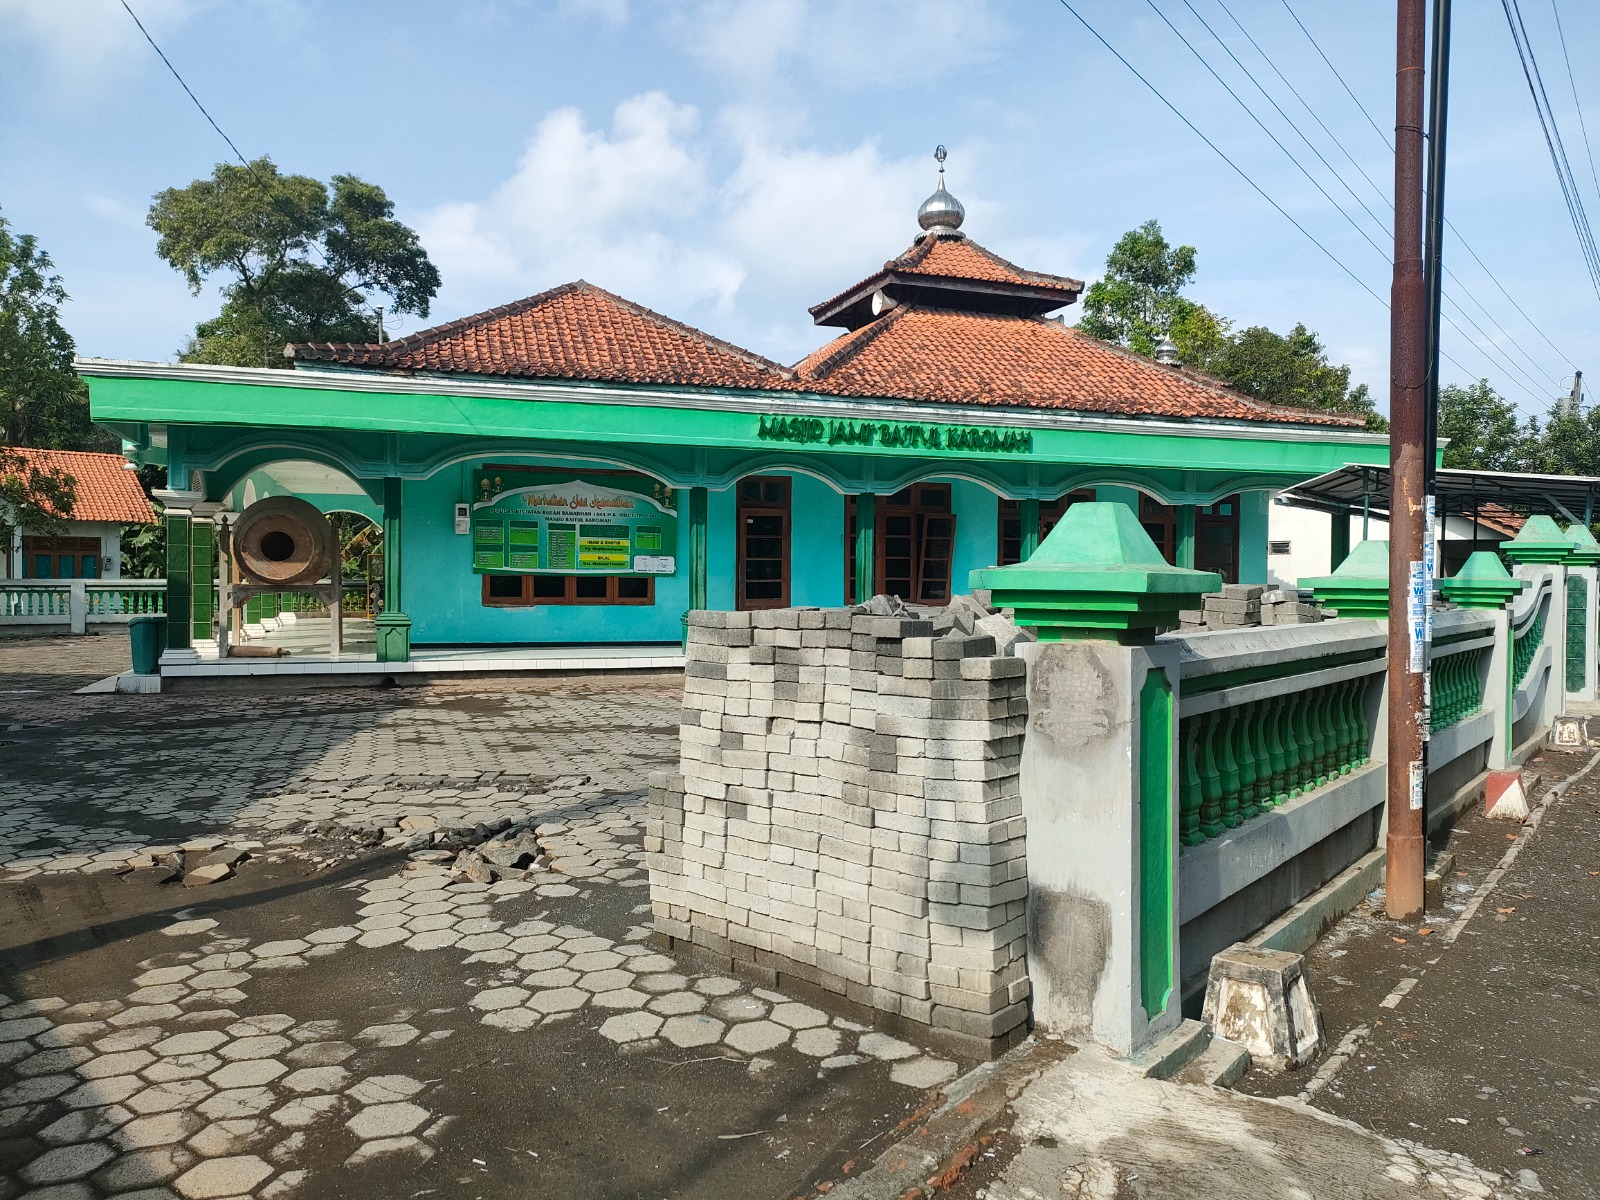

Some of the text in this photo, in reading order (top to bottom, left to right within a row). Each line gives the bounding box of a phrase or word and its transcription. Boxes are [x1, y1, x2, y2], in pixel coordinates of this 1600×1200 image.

[758, 415, 825, 444] MASJID
[877, 423, 944, 450] BAITUL
[945, 426, 1034, 454] KAROMAH
[521, 493, 568, 507] Marhaban
[590, 494, 635, 509] Ramadhan
